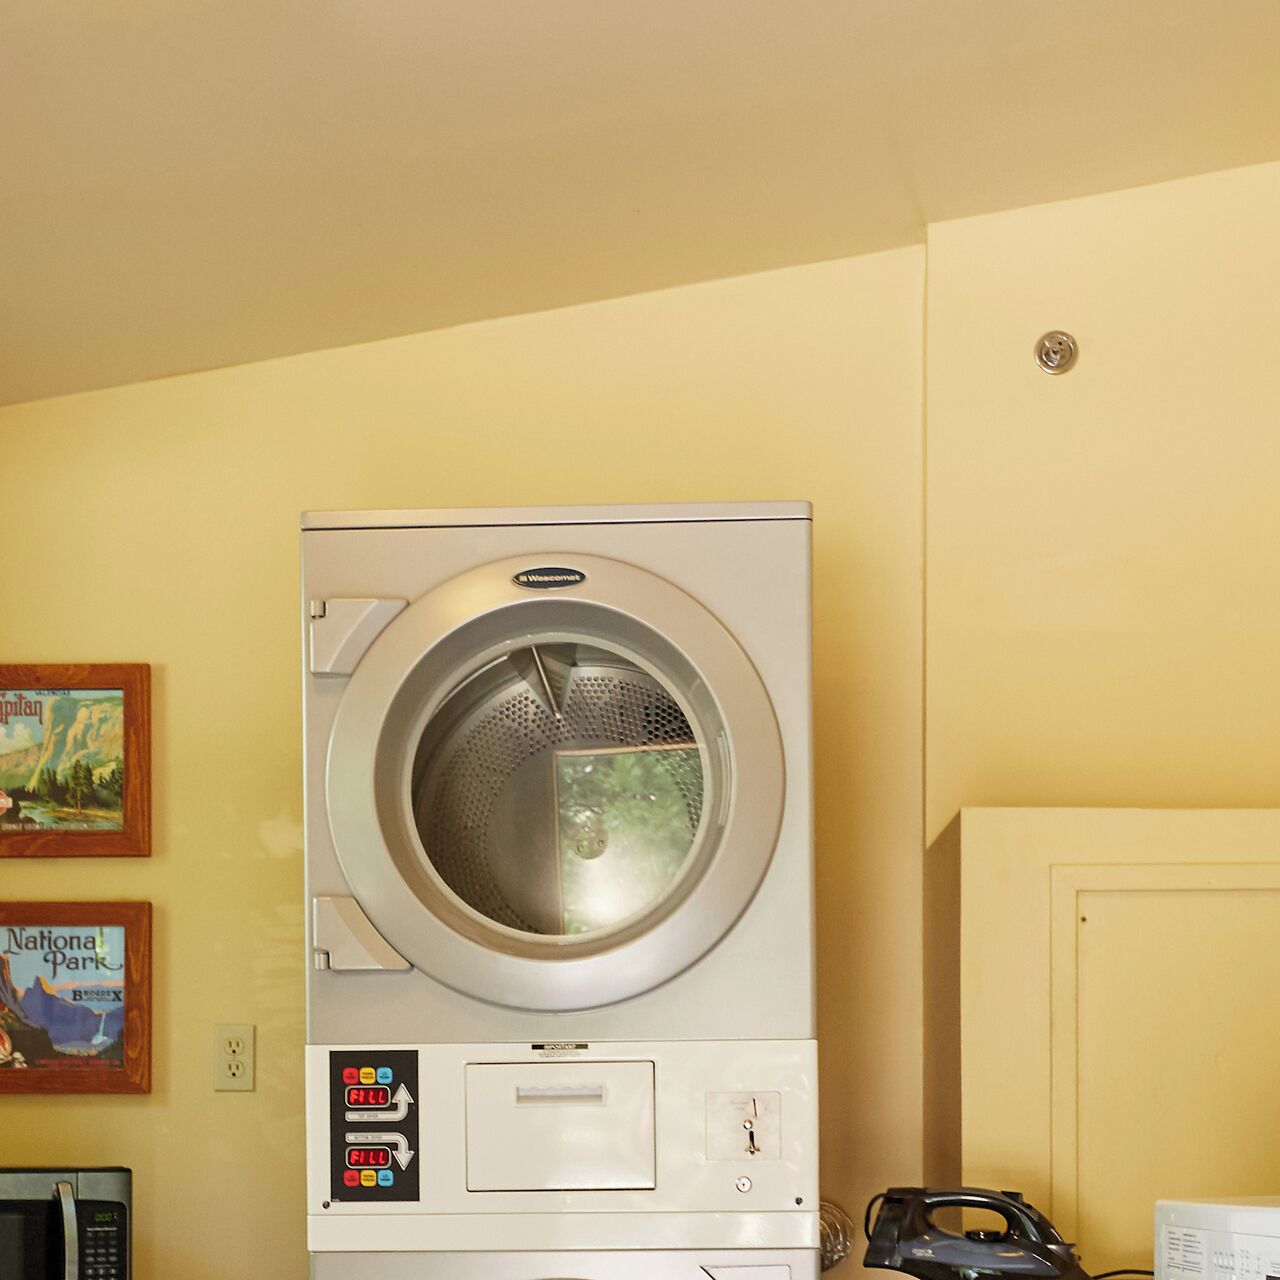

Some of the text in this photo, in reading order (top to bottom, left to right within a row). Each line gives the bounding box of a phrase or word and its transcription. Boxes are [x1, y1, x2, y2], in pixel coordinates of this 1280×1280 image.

[527, 574, 581, 582] Wascomat
[43, 949, 123, 980] Park
[350, 1089, 386, 1104] FILL
[350, 1150, 386, 1164] FILL
